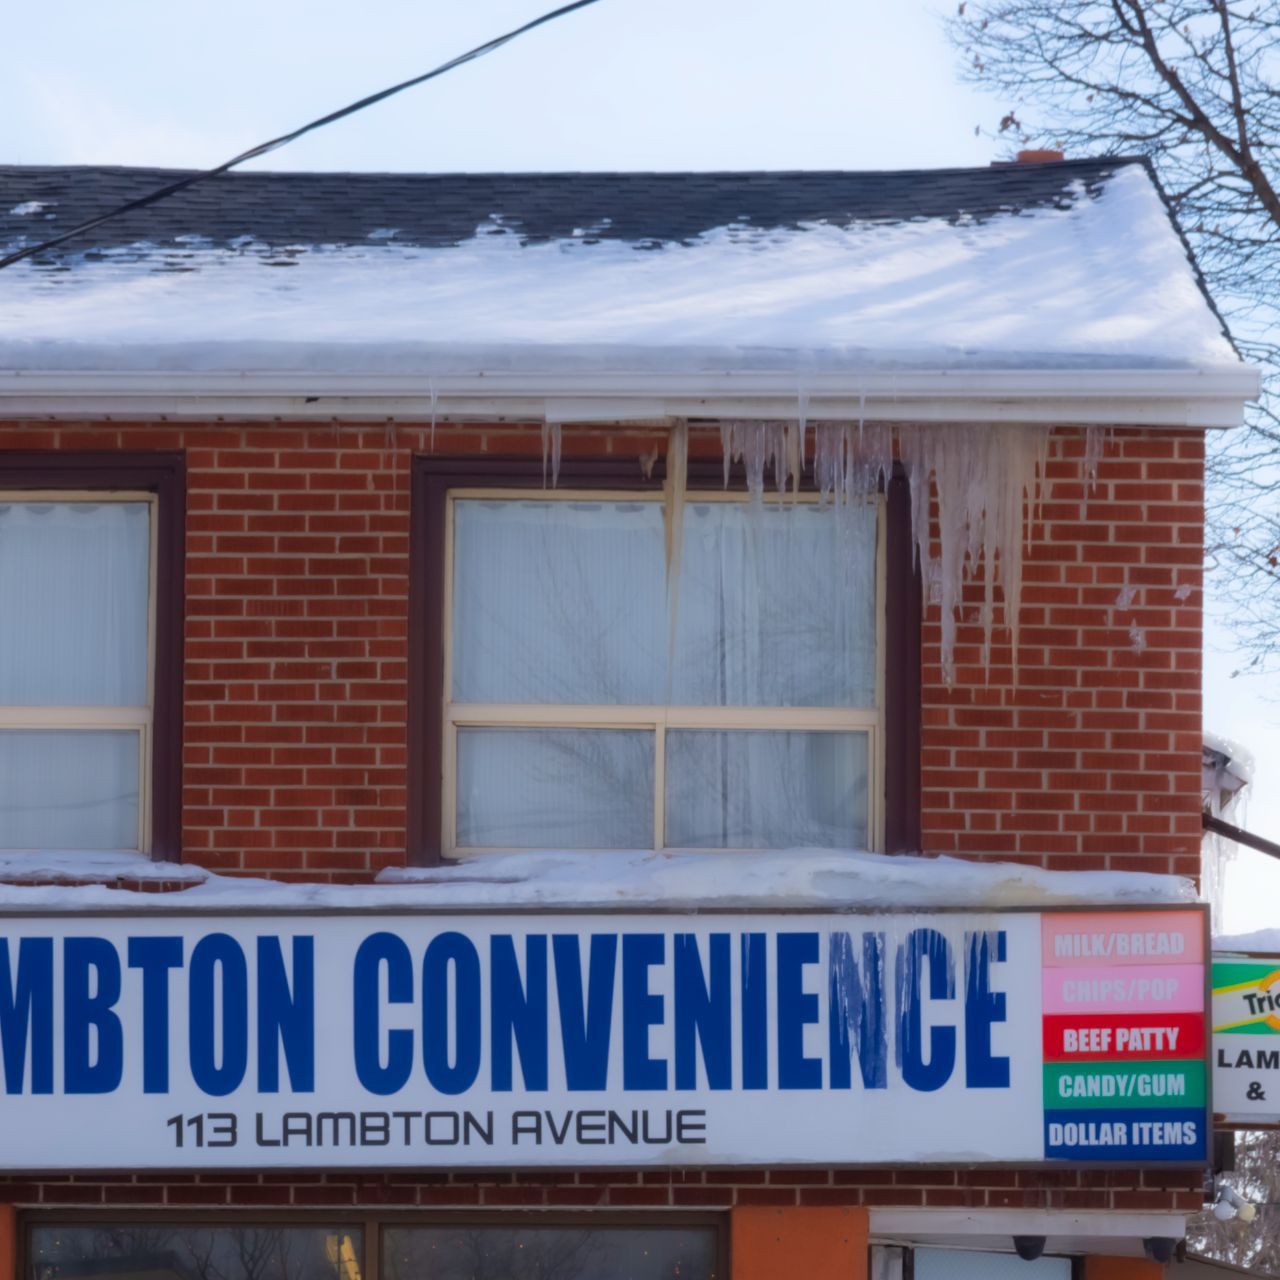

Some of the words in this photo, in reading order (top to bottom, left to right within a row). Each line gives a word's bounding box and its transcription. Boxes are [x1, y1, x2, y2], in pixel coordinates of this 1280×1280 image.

[1054, 931, 1185, 958] MILK/BREAD
[1062, 977, 1179, 1003] CHIPS/POP
[352, 928, 1011, 1096] CONVENIENCE
[1063, 1028, 1112, 1053] BEEF
[1115, 1026, 1180, 1052] PATTY
[1058, 1073, 1186, 1099] CANDY/GUM
[1245, 1081, 1266, 1102] &
[166, 1112, 238, 1148] 113
[255, 1111, 494, 1147] LAMBTON
[511, 1109, 707, 1145] AVENUE
[1048, 1122, 1128, 1147] DOLLAR
[1132, 1121, 1198, 1146] ITEMS
